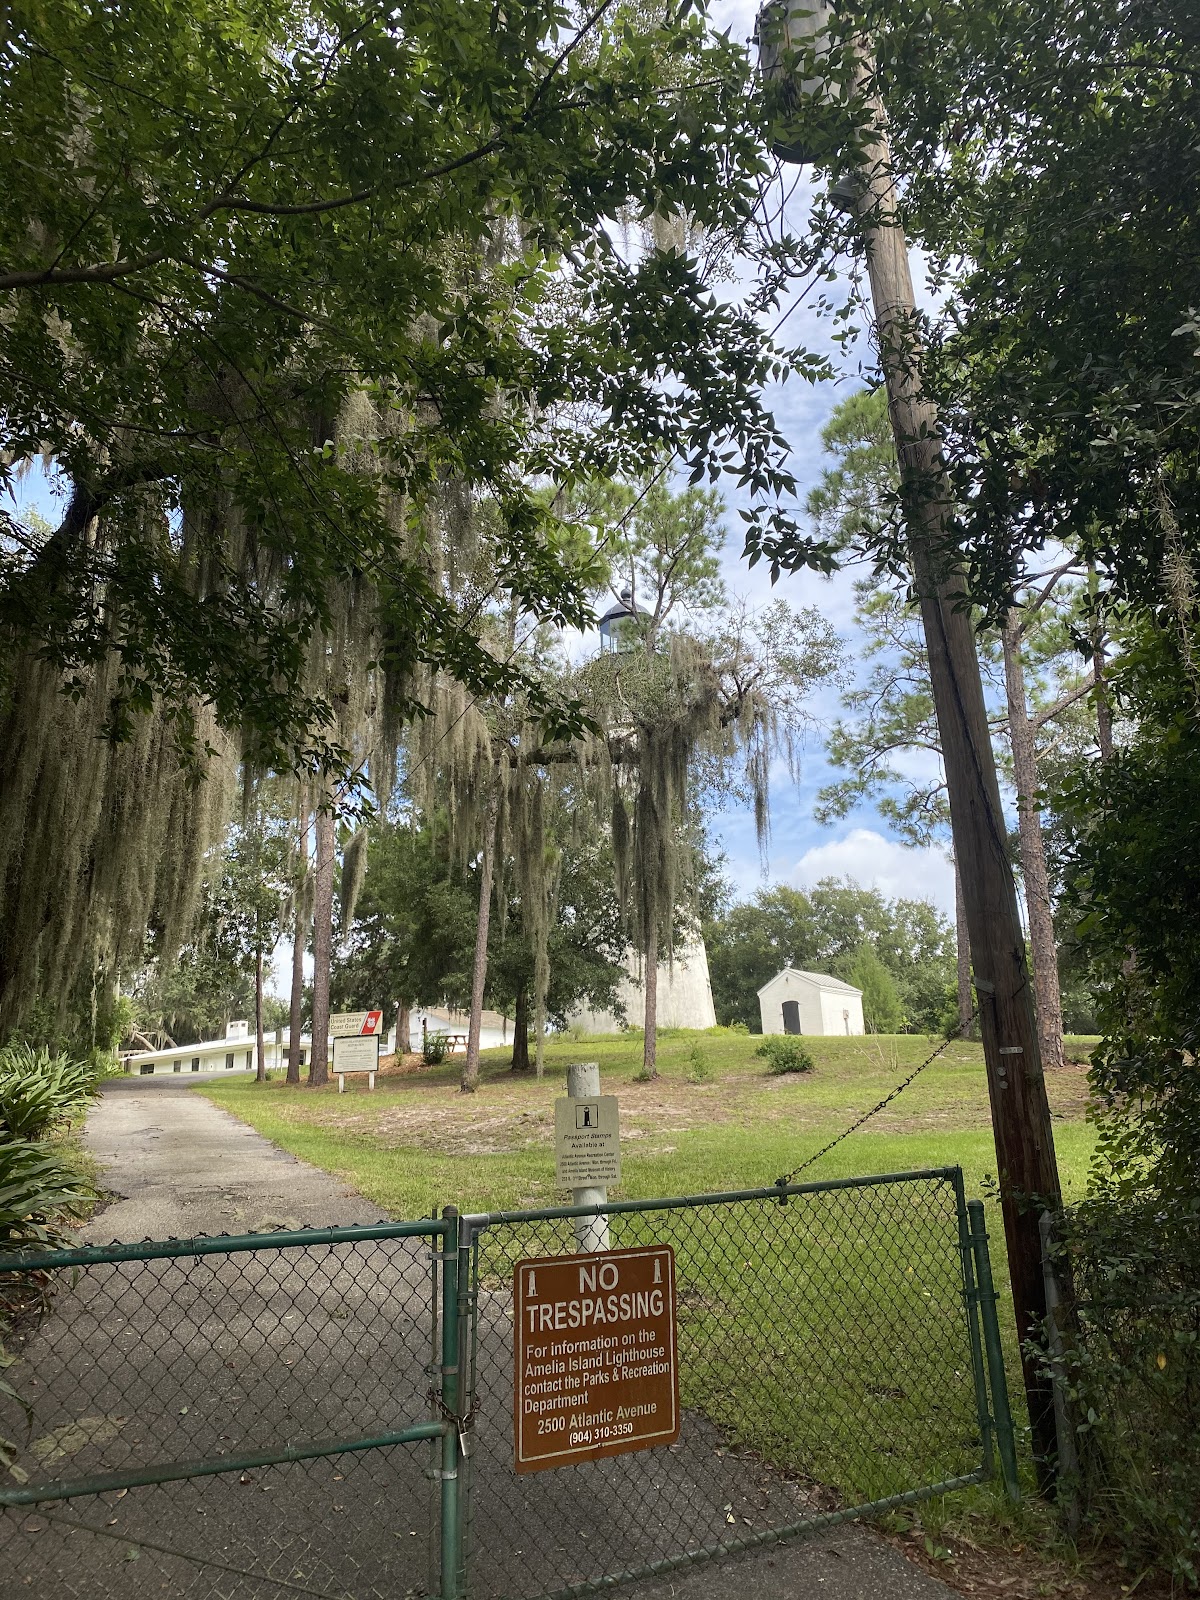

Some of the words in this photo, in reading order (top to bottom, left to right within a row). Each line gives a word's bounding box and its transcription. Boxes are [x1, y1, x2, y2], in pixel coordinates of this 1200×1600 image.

[579, 1263, 618, 1294] NO
[526, 1289, 664, 1332] TRESPASSING
[526, 1344, 548, 1359] For
[551, 1335, 618, 1357] information
[621, 1333, 636, 1345] on
[638, 1329, 656, 1343] the
[524, 1360, 565, 1378] Amelia
[569, 1352, 603, 1371] Island
[606, 1346, 665, 1367] Lighthouse
[524, 1377, 562, 1395] contact
[565, 1375, 580, 1390] the
[583, 1370, 610, 1387] Parks
[612, 1368, 619, 1381] &
[621, 1360, 670, 1380] Recreation
[524, 1391, 589, 1415] Department
[537, 1417, 566, 1435] 2500
[569, 1408, 613, 1429] Atlantic
[616, 1403, 657, 1420] Avenue
[569, 1430, 592, 1447] (904)
[594, 1423, 633, 1440] 310-3350
